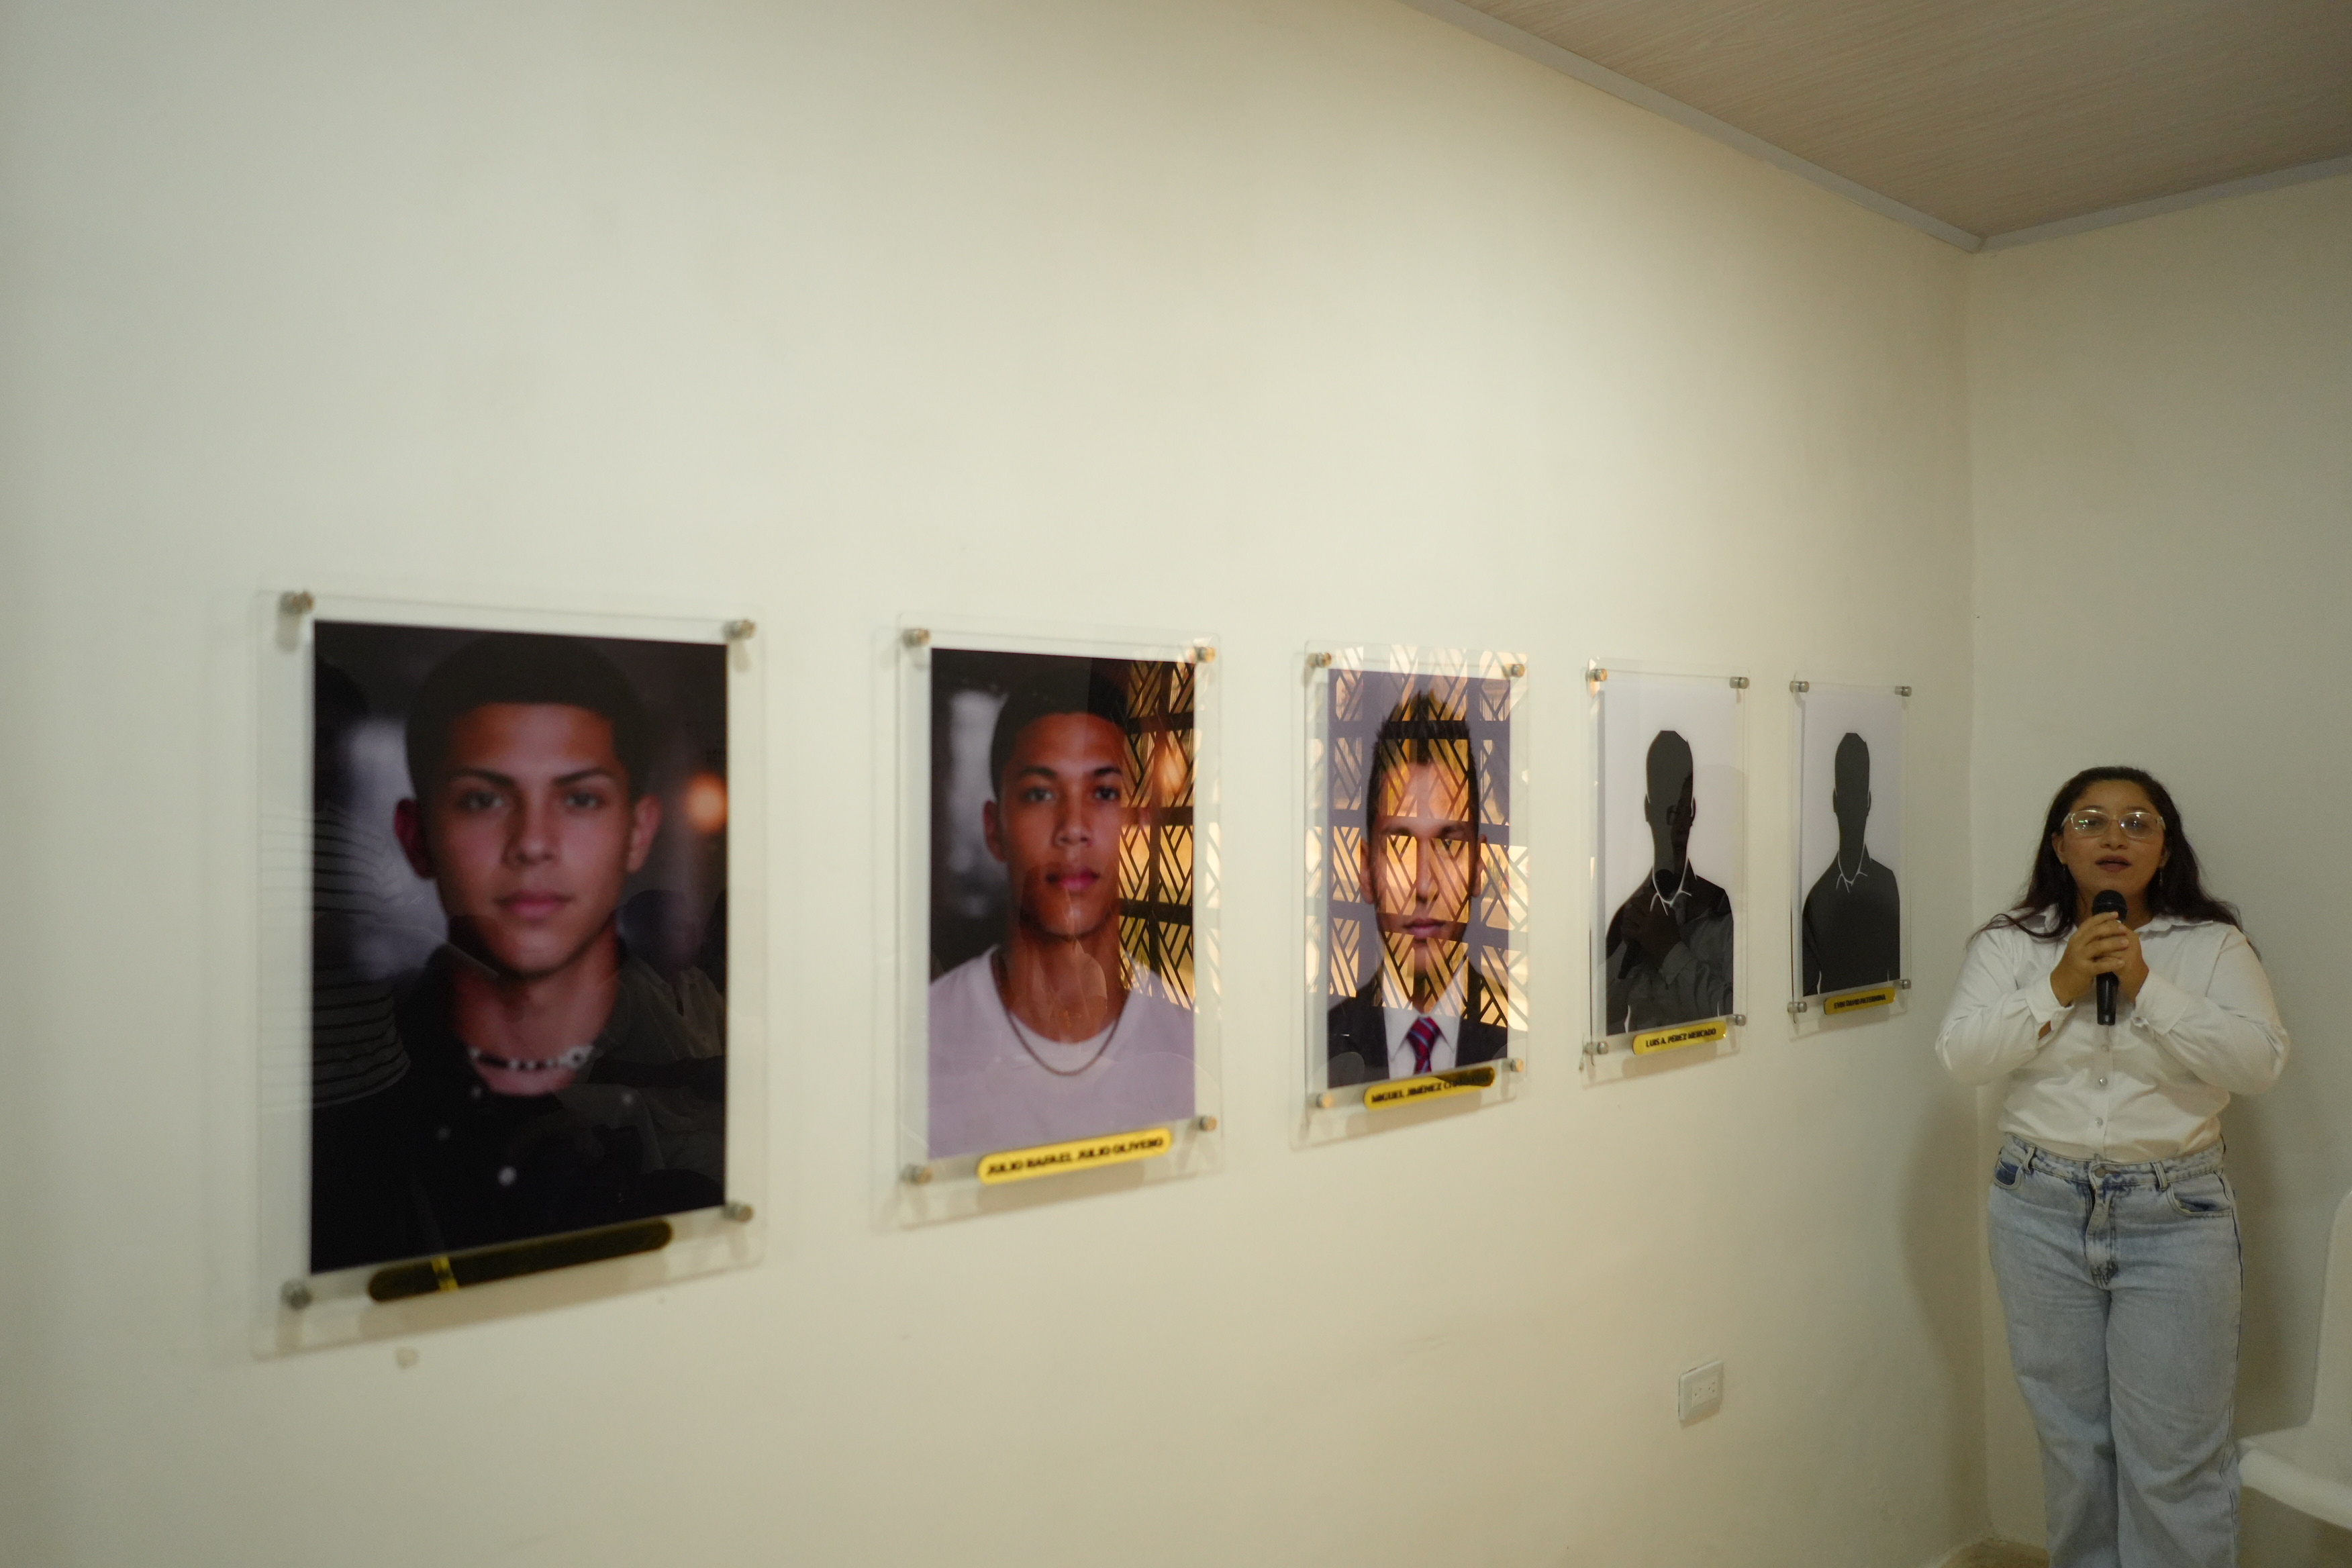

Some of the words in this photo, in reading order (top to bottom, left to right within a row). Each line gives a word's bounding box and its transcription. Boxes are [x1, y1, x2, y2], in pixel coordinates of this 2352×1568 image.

[1645, 1037, 1660, 1047] LUIS
[1687, 1028, 1716, 1039] MERCADO
[1371, 1089, 1405, 1103] MIGUEL
[987, 1161, 1024, 1177] JULIO
[1027, 1152, 1074, 1168] RAFAEL
[1077, 1145, 1112, 1161] JULIO
